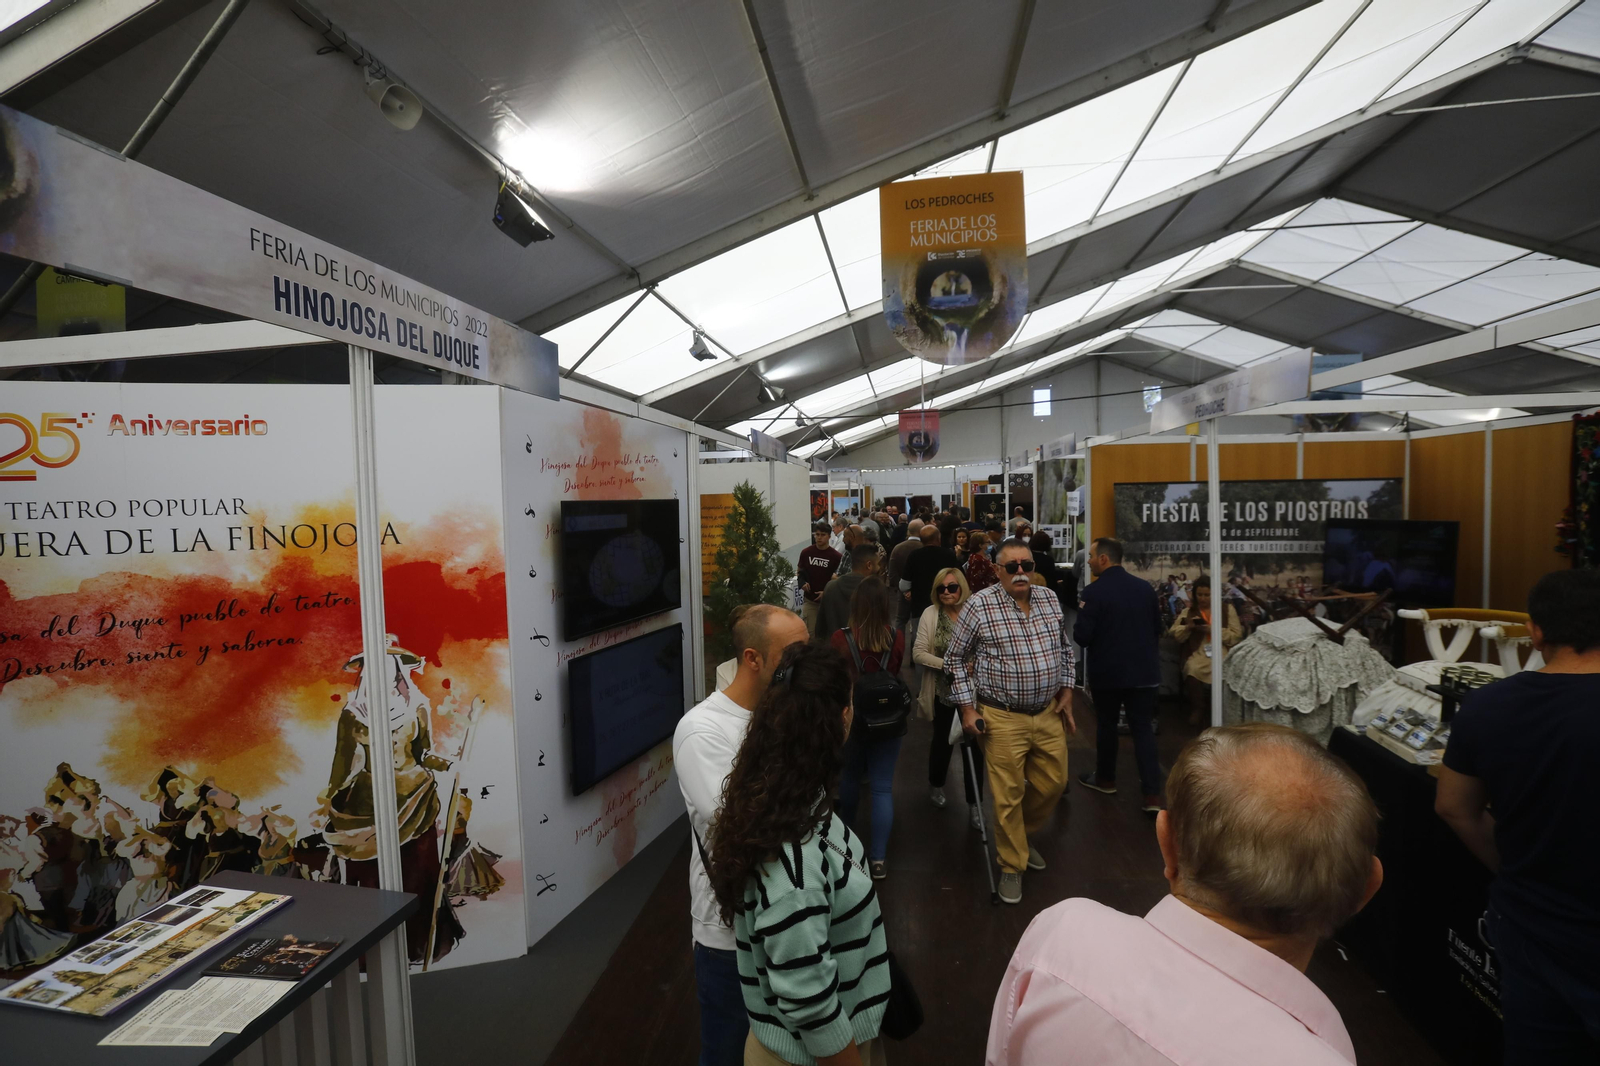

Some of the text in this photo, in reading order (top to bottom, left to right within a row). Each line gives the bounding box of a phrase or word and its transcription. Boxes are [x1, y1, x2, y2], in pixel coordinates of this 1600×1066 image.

[906, 192, 994, 210] LOS PEDROCHES
[910, 214, 996, 234] FERIA DE LOS
[910, 228, 998, 247] MUNICIPIOS
[250, 228, 488, 338] FERIA DE LOS MUNICIPIOS 2022
[273, 275, 480, 370] HINOJOSA DEL DUQUE
[1194, 397, 1226, 418] PEDROCHE
[0, 413, 268, 482] 25 Aniversario
[4, 498, 249, 520] TEATRO POPULAR
[1142, 500, 1369, 523] FIESTA E LOS PIOSTROS
[0, 522, 402, 558] ERA DE LA FINOJOA
[1222, 528, 1227, 536] 8
[1230, 528, 1242, 536] de
[1244, 528, 1300, 537] SEPTIEMBRE
[1144, 544, 1192, 552] DECLARADA
[1196, 543, 1206, 552] DE
[1220, 542, 1245, 552] TERÉS
[1249, 542, 1294, 552] TURÍSTICO
[1299, 543, 1309, 552] DE
[808, 556, 830, 568] VANS
[40, 614, 82, 642] del
[95, 612, 168, 640] Duque
[180, 598, 250, 632] pueblo
[260, 592, 285, 618] de
[126, 642, 188, 664] siente
[196, 645, 212, 666] y
[1448, 927, 1482, 967] Fuente
